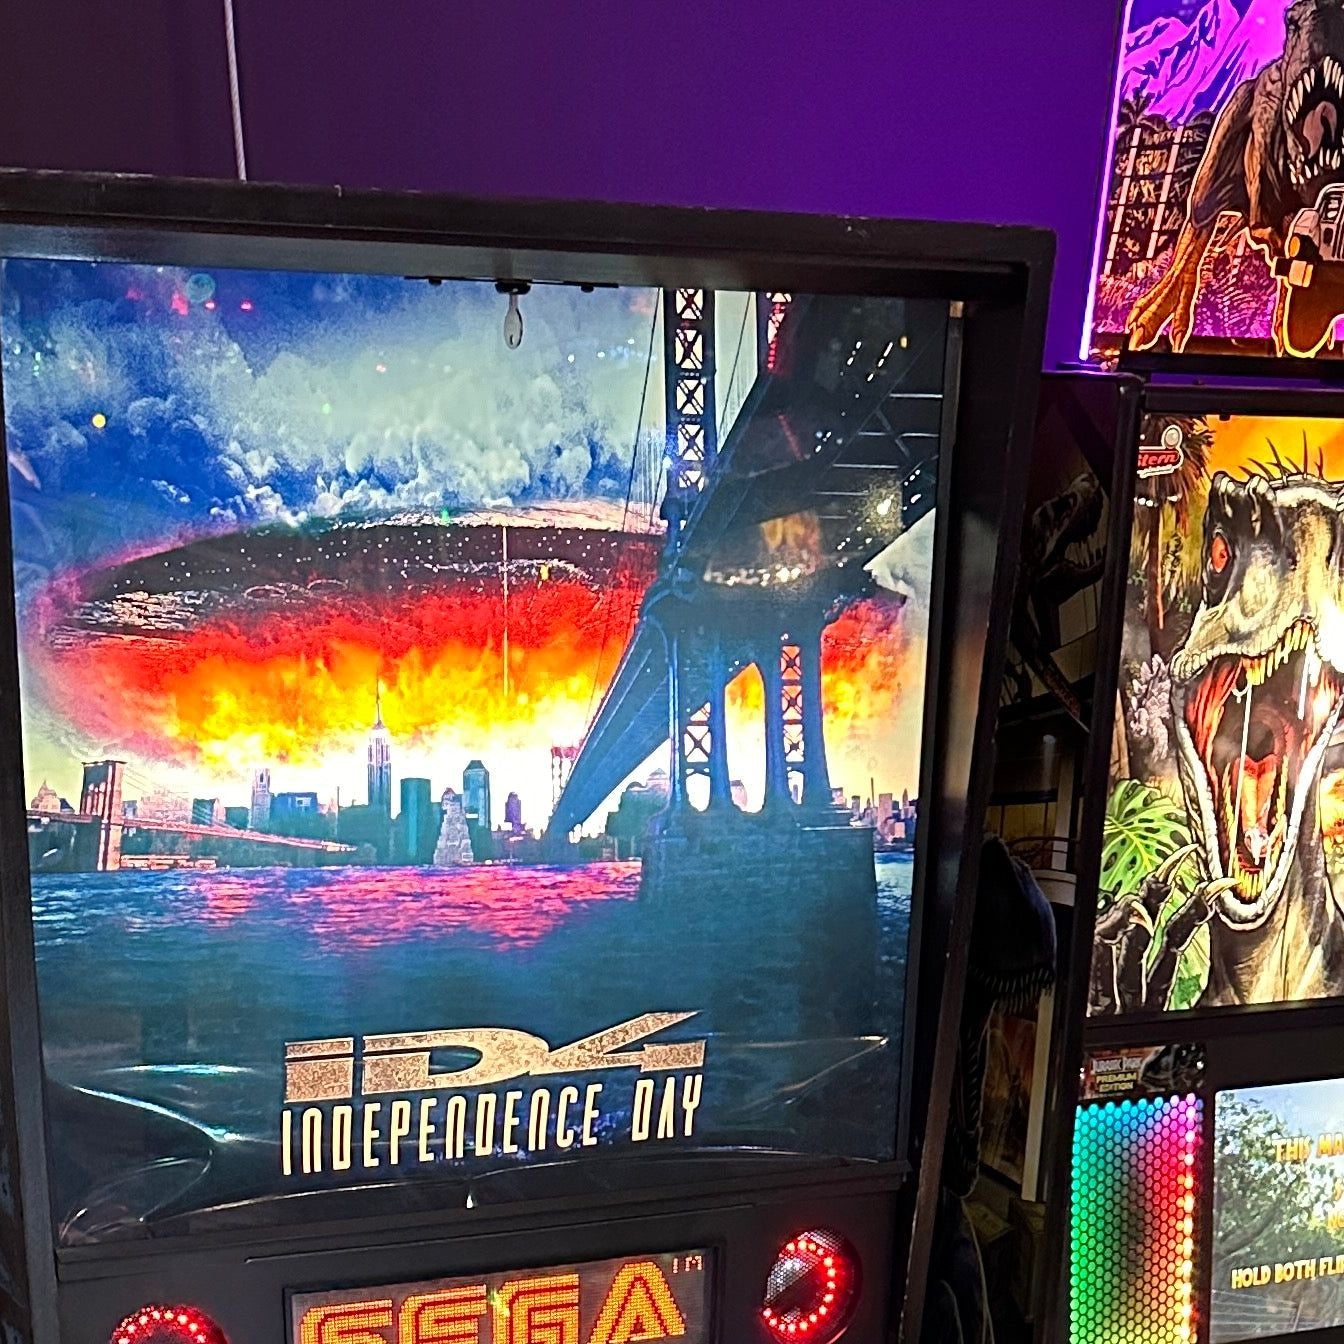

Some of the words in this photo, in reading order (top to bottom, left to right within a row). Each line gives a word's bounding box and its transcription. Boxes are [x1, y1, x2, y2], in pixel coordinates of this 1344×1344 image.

[281, 1083, 604, 1176] INDEPENDENCE
[631, 1074, 703, 1142] DAY
[1272, 1137, 1312, 1163] THIS
[1231, 1269, 1272, 1290] HOLD
[1274, 1261, 1316, 1285] BOTH
